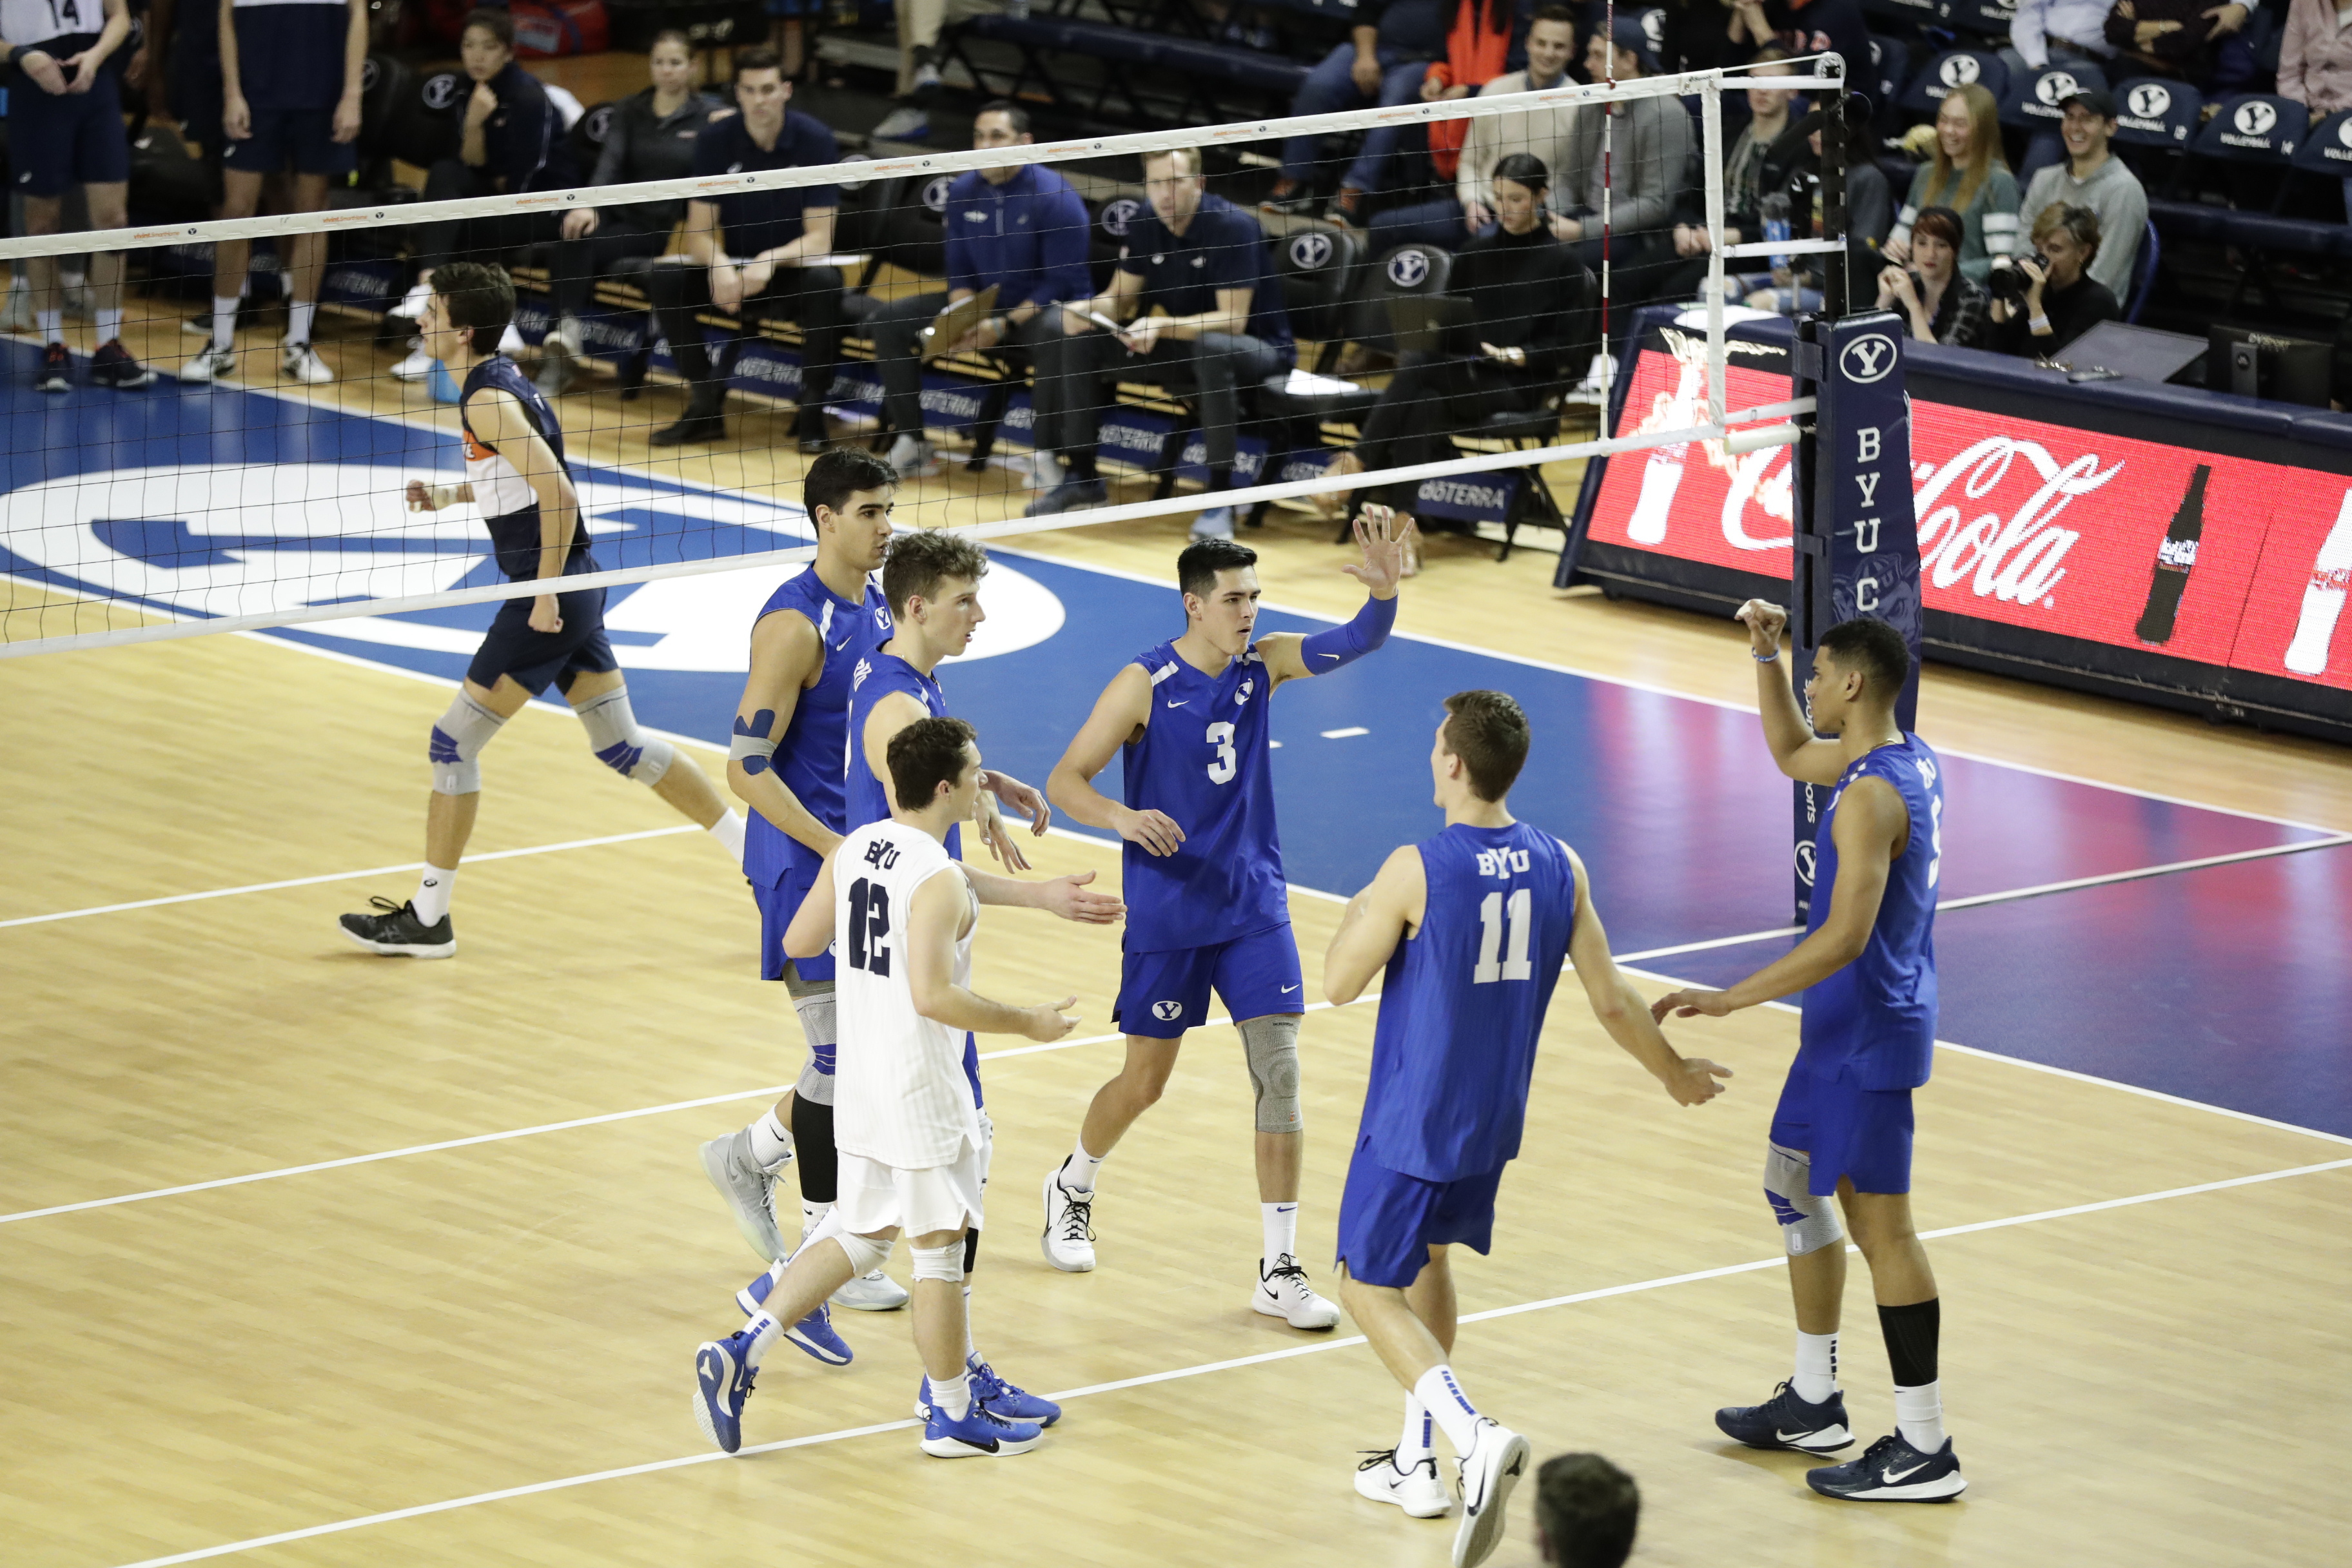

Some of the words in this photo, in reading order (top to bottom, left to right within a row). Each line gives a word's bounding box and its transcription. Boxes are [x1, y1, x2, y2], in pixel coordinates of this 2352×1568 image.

[1850, 341, 1887, 376] Y
[1206, 721, 1237, 785] 3
[864, 838, 901, 870] BYU
[1475, 847, 1531, 880] BYU
[848, 876, 890, 979] 12
[1473, 888, 1532, 985] 11
